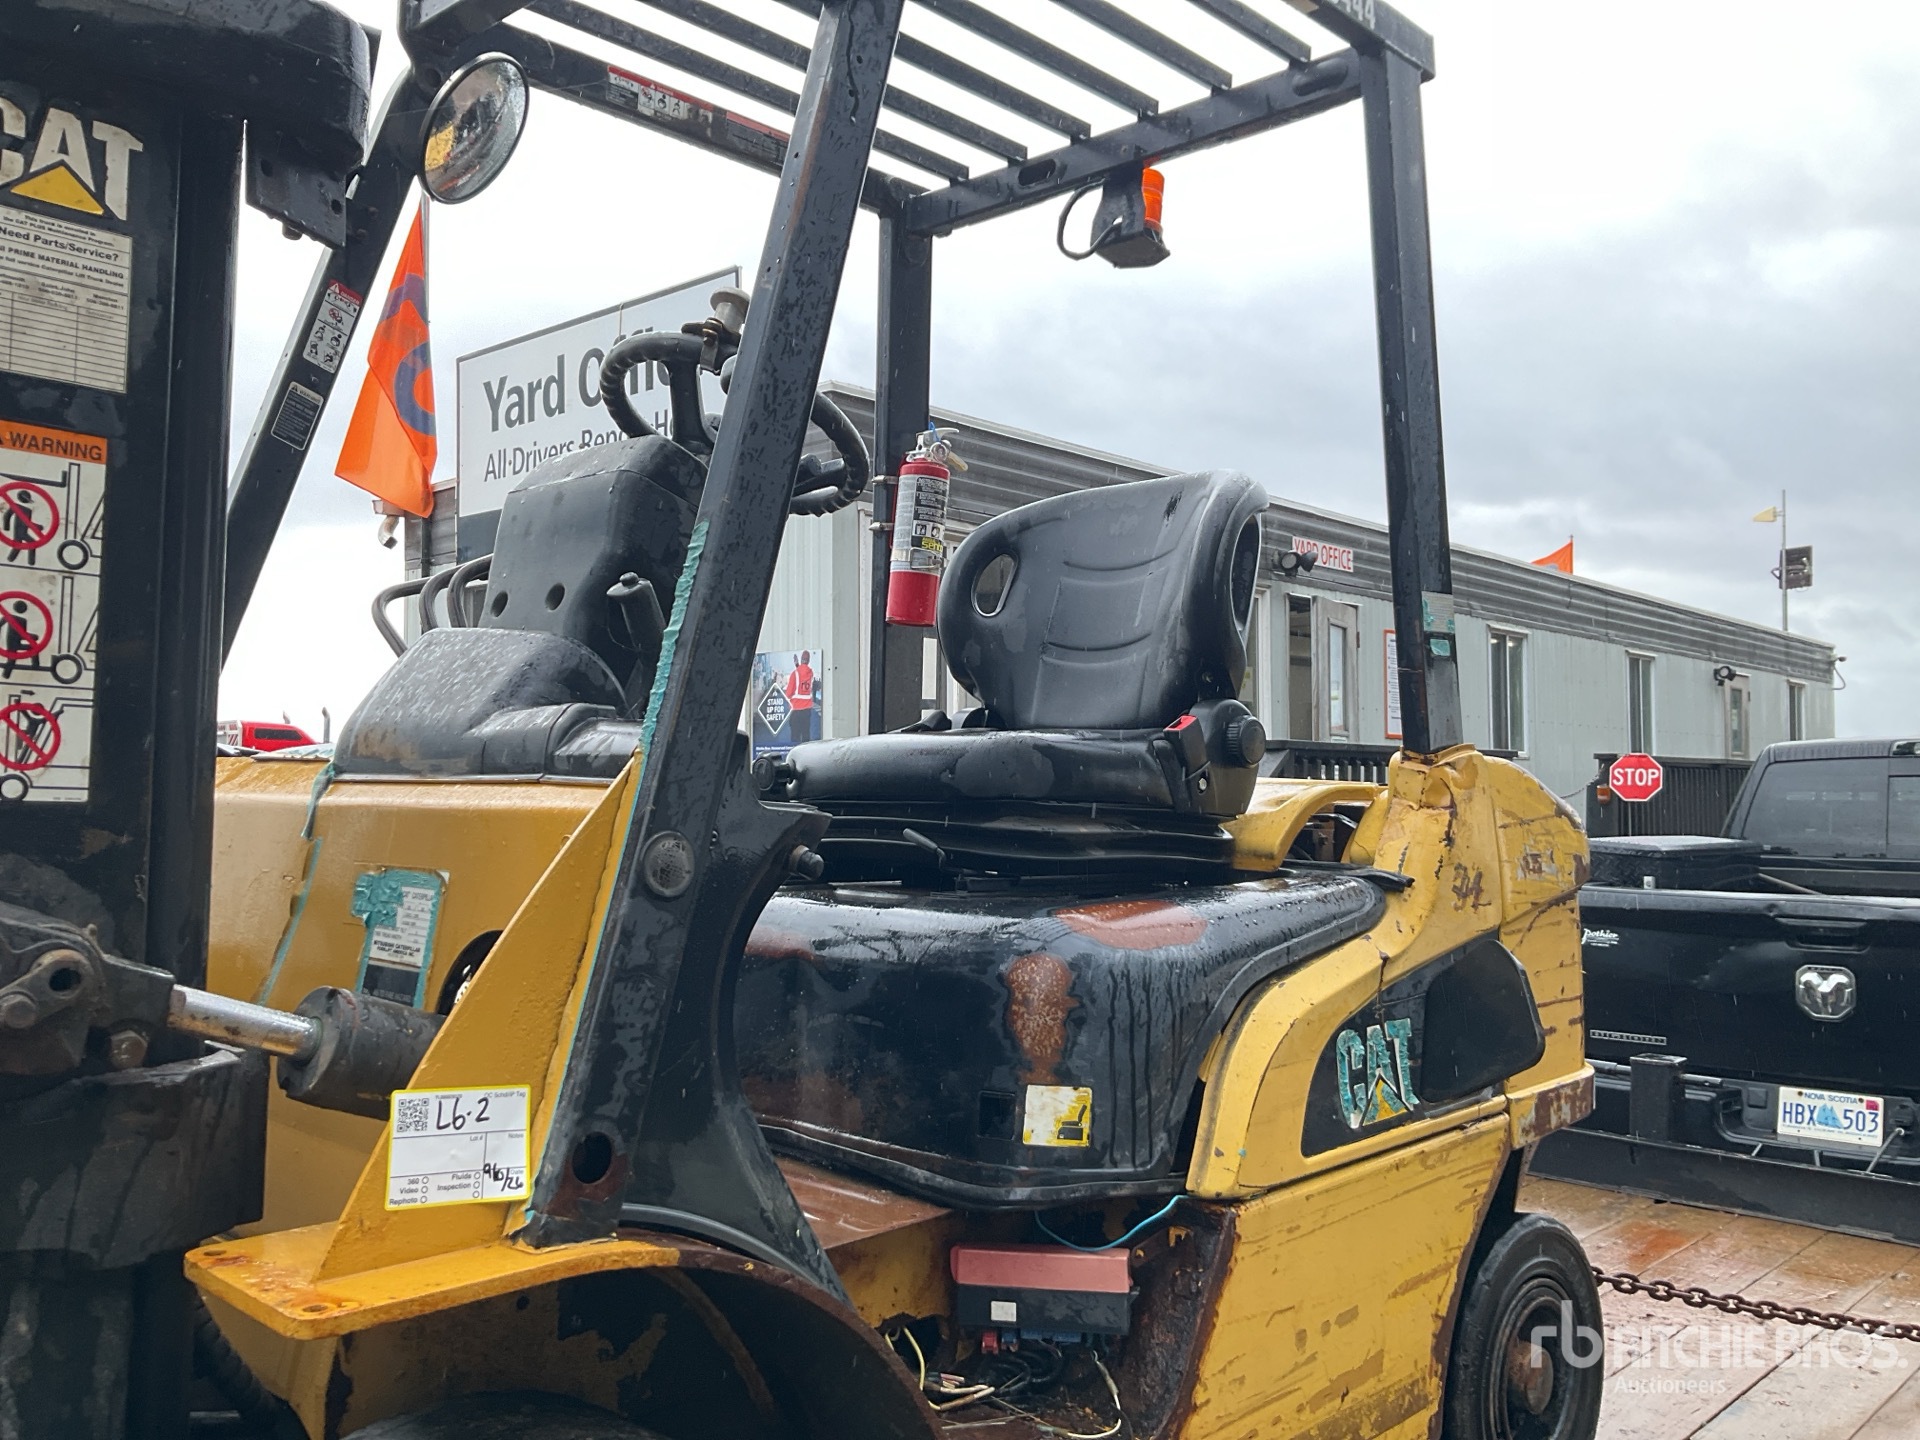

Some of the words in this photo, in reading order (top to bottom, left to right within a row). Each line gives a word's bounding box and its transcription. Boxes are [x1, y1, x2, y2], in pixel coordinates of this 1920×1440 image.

[0, 227, 30, 241] Need
[34, 233, 119, 261] Parts/Service?
[8, 246, 36, 259] PRIME
[38, 253, 80, 269] MATERIAL
[82, 263, 124, 280] HANDLING
[483, 354, 566, 432] Yard
[9, 431, 102, 461] WARNING
[484, 433, 507, 482] All
[1321, 544, 1352, 570] OFFICE
[767, 698, 784, 706] STAND
[774, 705, 785, 713] FOR
[766, 713, 786, 721] SAFETY
[1612, 768, 1660, 787] STOP
[1336, 1018, 1420, 1129] CAT
[1804, 1092, 1826, 1101] NOVA
[1828, 1094, 1859, 1105] SCOTIA
[1783, 1101, 1818, 1127] HBX
[1842, 1108, 1880, 1133] 503
[408, 1177, 420, 1185] 360
[452, 1173, 472, 1181] Fluids
[437, 1182, 472, 1191] Inspection
[389, 1197, 418, 1206] Rephoto
